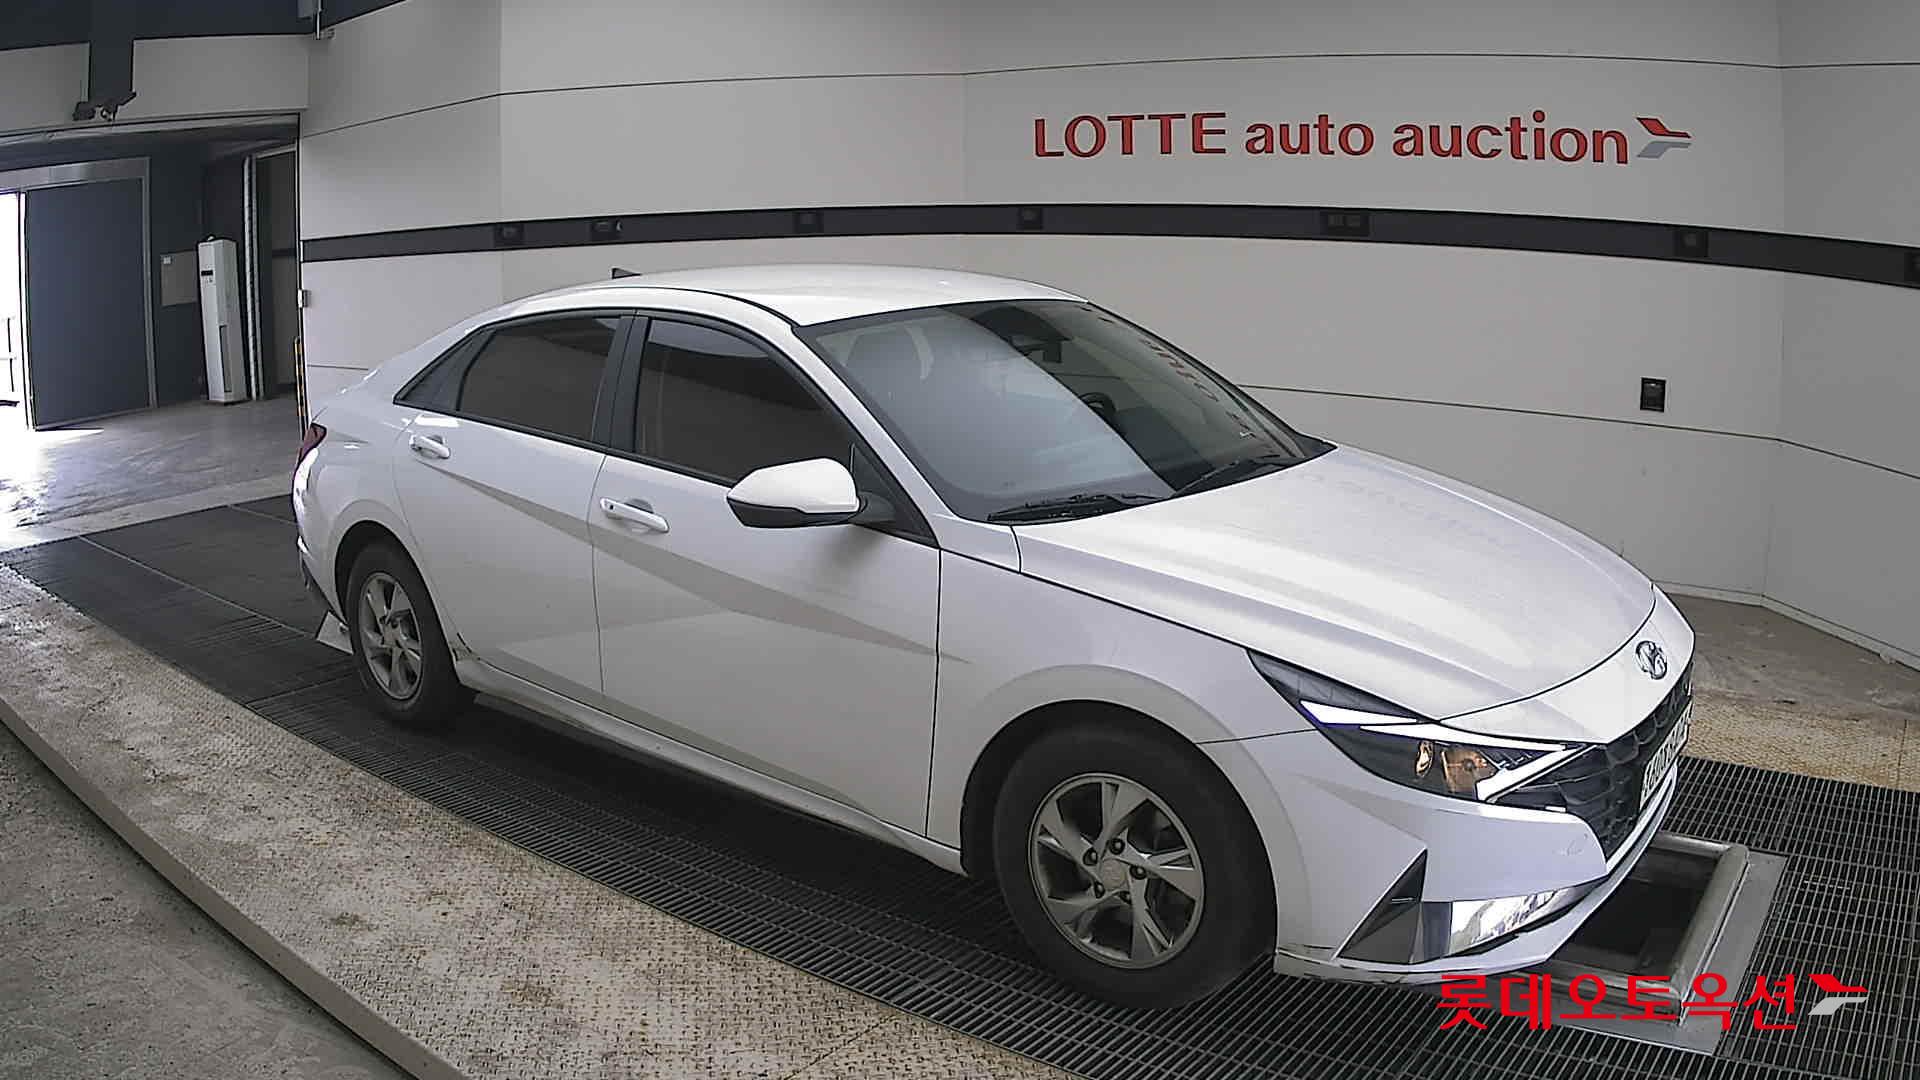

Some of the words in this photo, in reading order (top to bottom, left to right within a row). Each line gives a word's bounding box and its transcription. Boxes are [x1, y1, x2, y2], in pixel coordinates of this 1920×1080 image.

[1035, 113, 1226, 158] LOTTE
[1246, 114, 1374, 156] auto
[1393, 110, 1629, 164] auction
